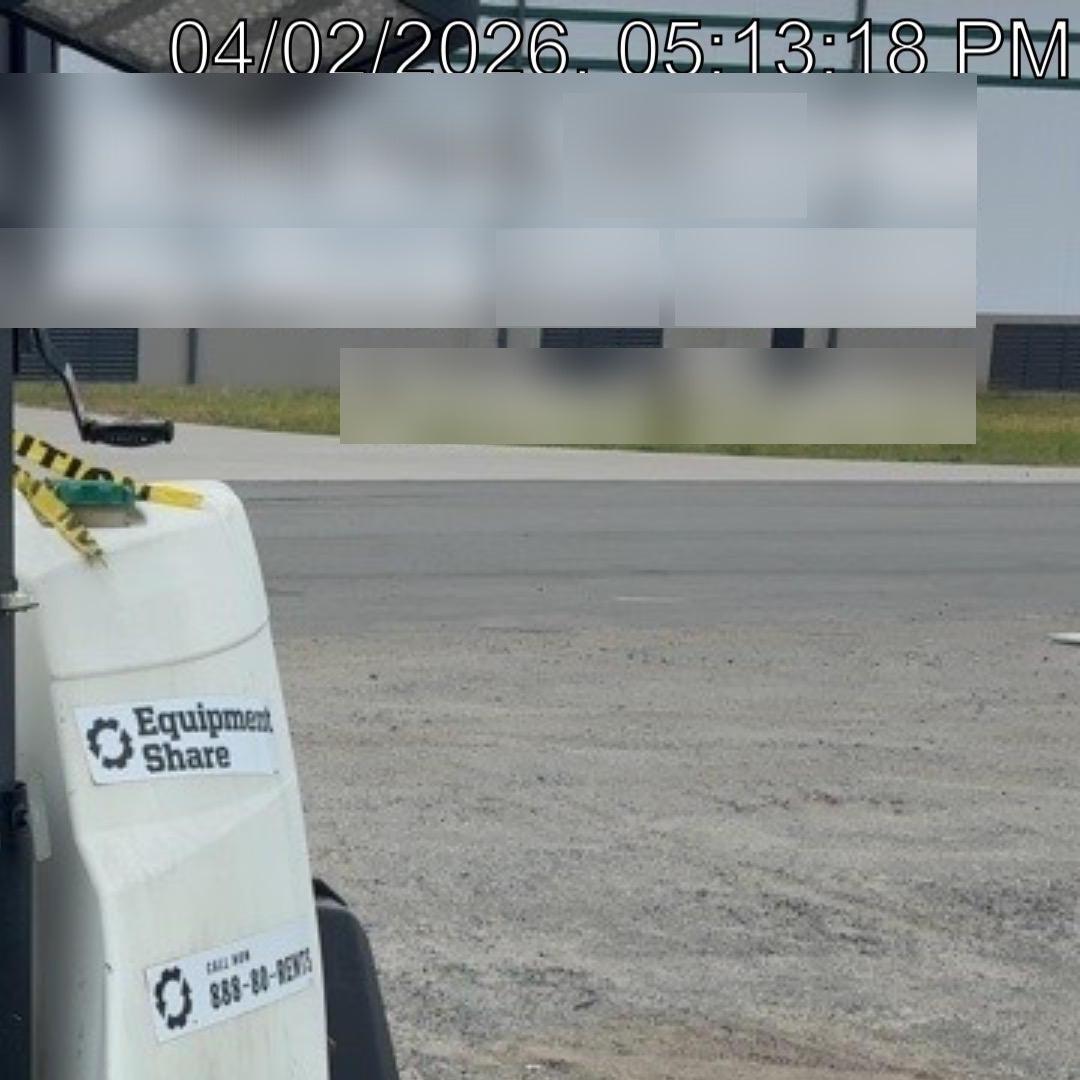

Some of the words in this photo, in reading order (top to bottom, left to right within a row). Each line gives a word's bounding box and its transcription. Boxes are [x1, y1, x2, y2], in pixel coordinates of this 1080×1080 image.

[132, 702, 274, 740] Equipment
[143, 742, 231, 774] Share
[209, 947, 313, 1009] 888-80-RENTS
